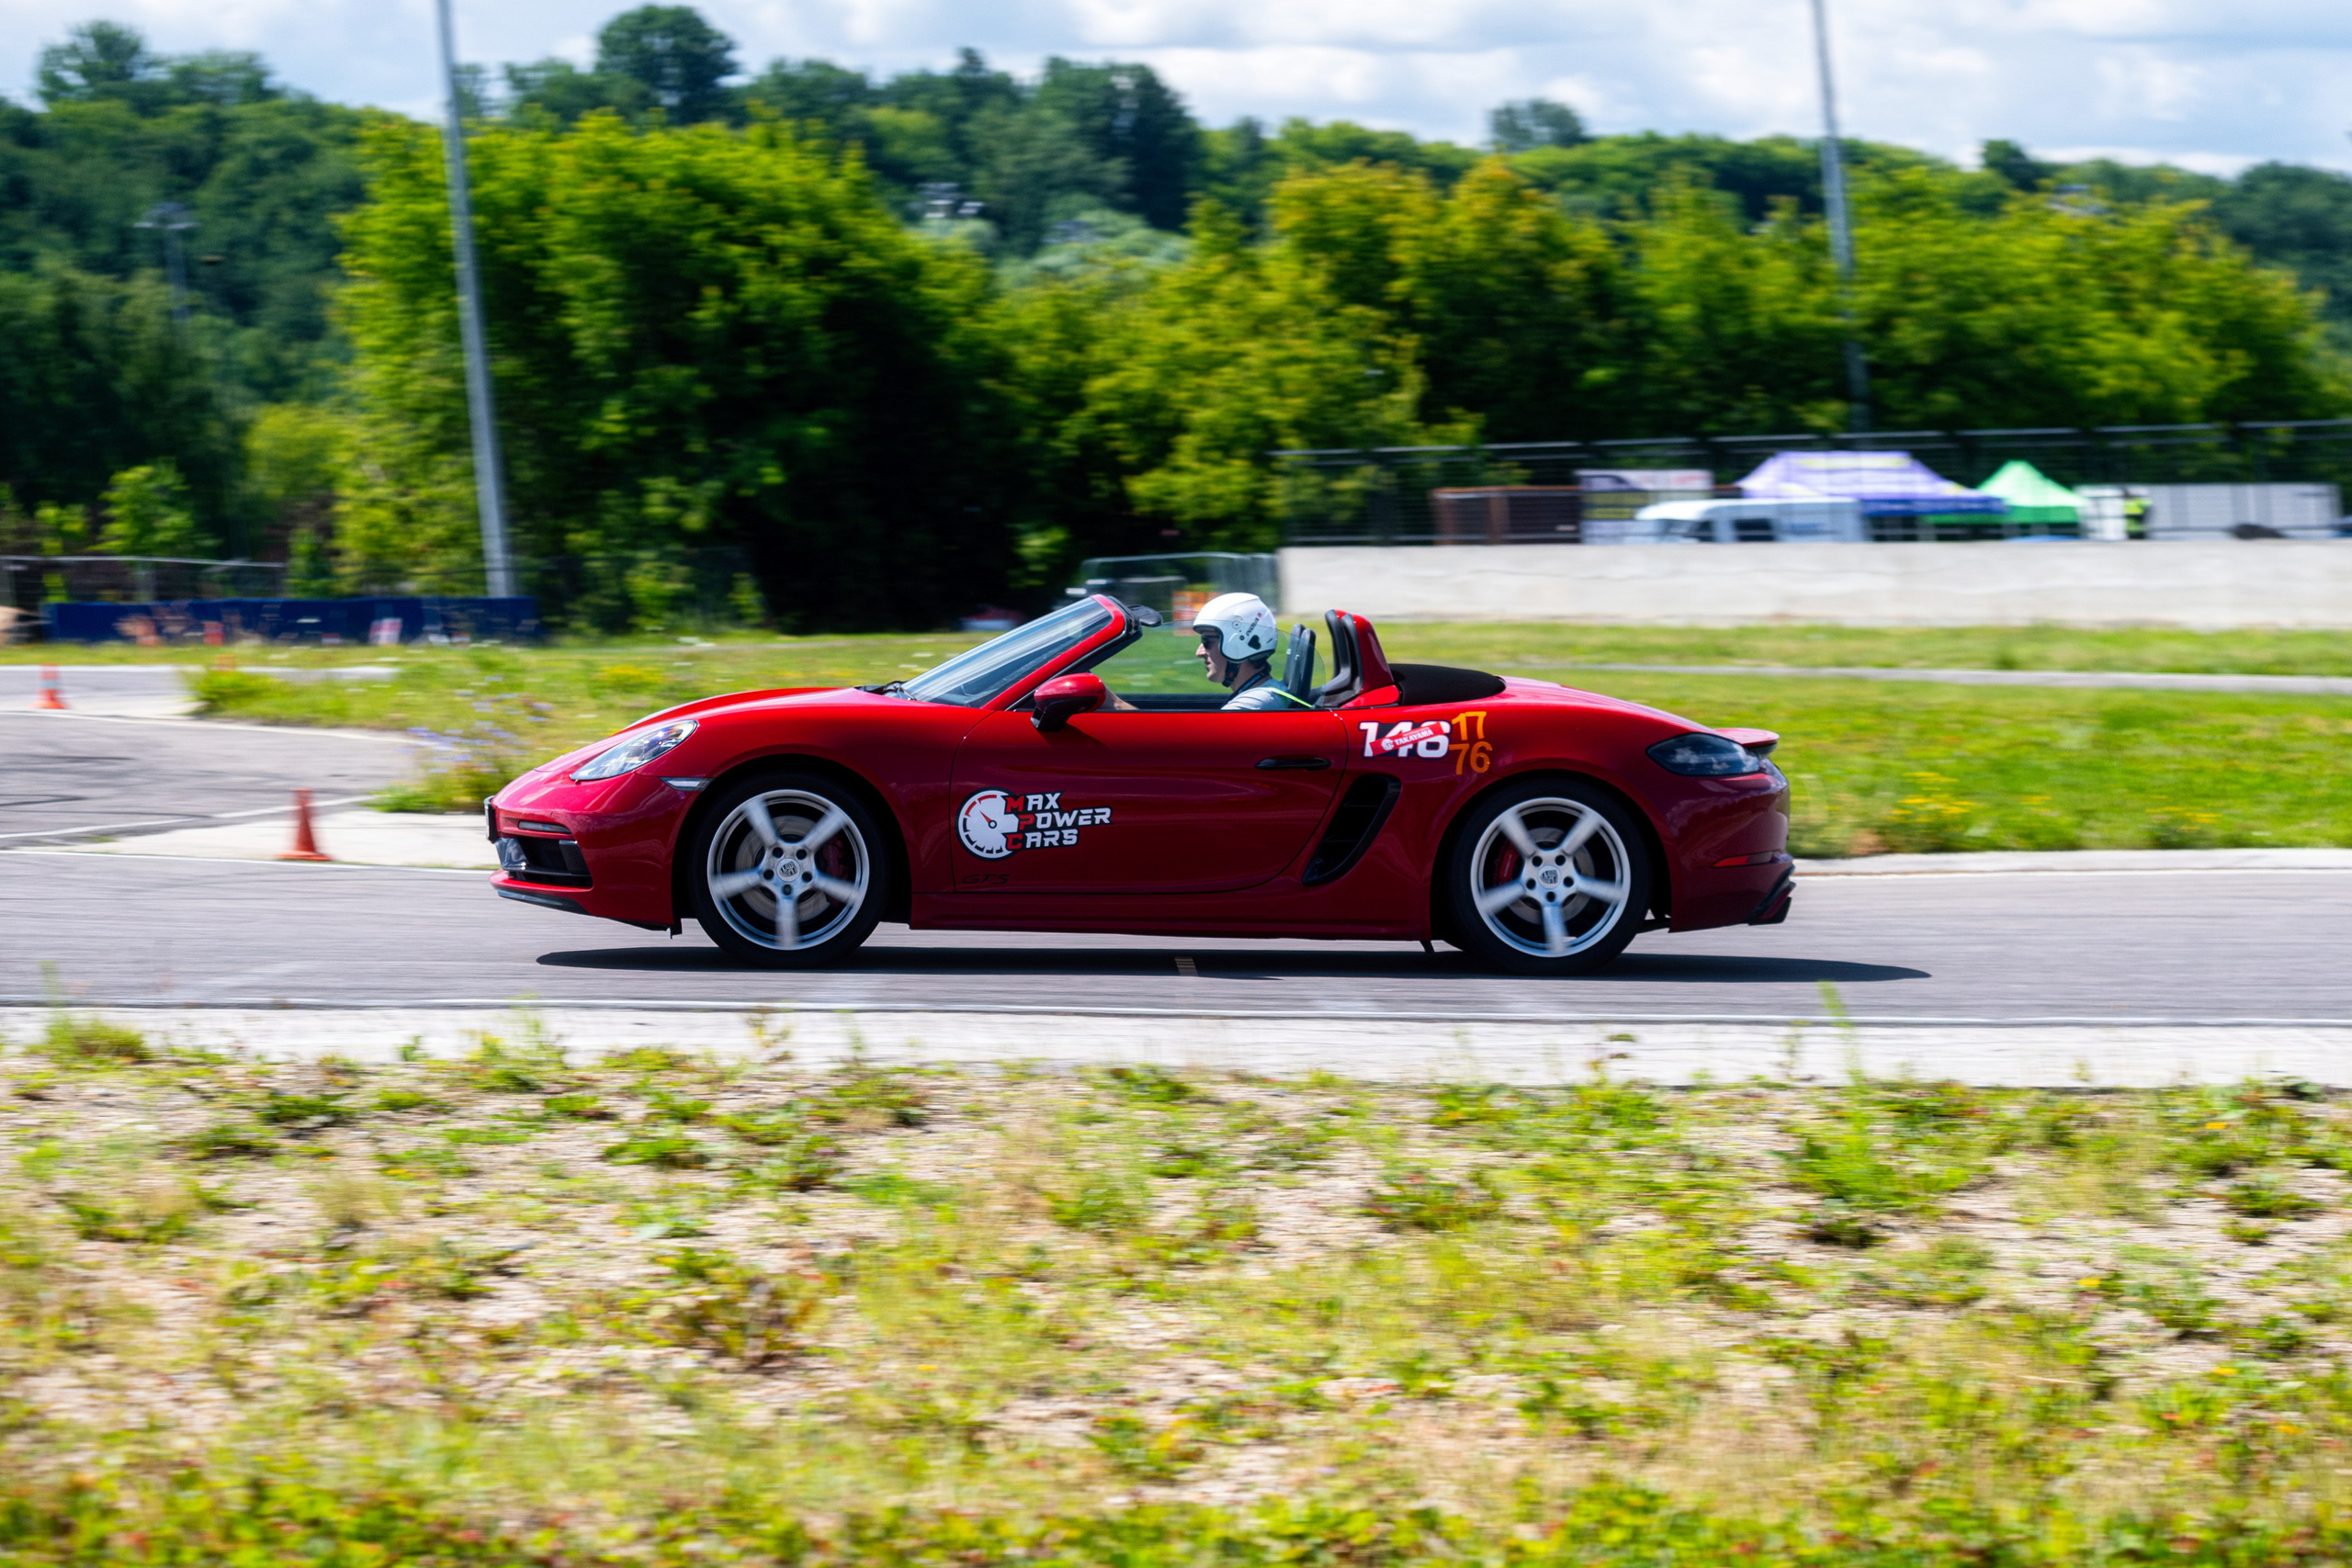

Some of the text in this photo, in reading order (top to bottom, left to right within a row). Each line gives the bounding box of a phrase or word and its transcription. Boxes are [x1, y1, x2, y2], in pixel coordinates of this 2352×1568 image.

[1452, 711, 1487, 740] 17
[1394, 729, 1433, 745] TAKAYAMA
[1449, 741, 1493, 775] 76
[1005, 792, 1061, 812] MAX
[1018, 807, 1112, 830] POWER
[1006, 829, 1079, 851] CARS
[962, 874, 1010, 885] GTS
